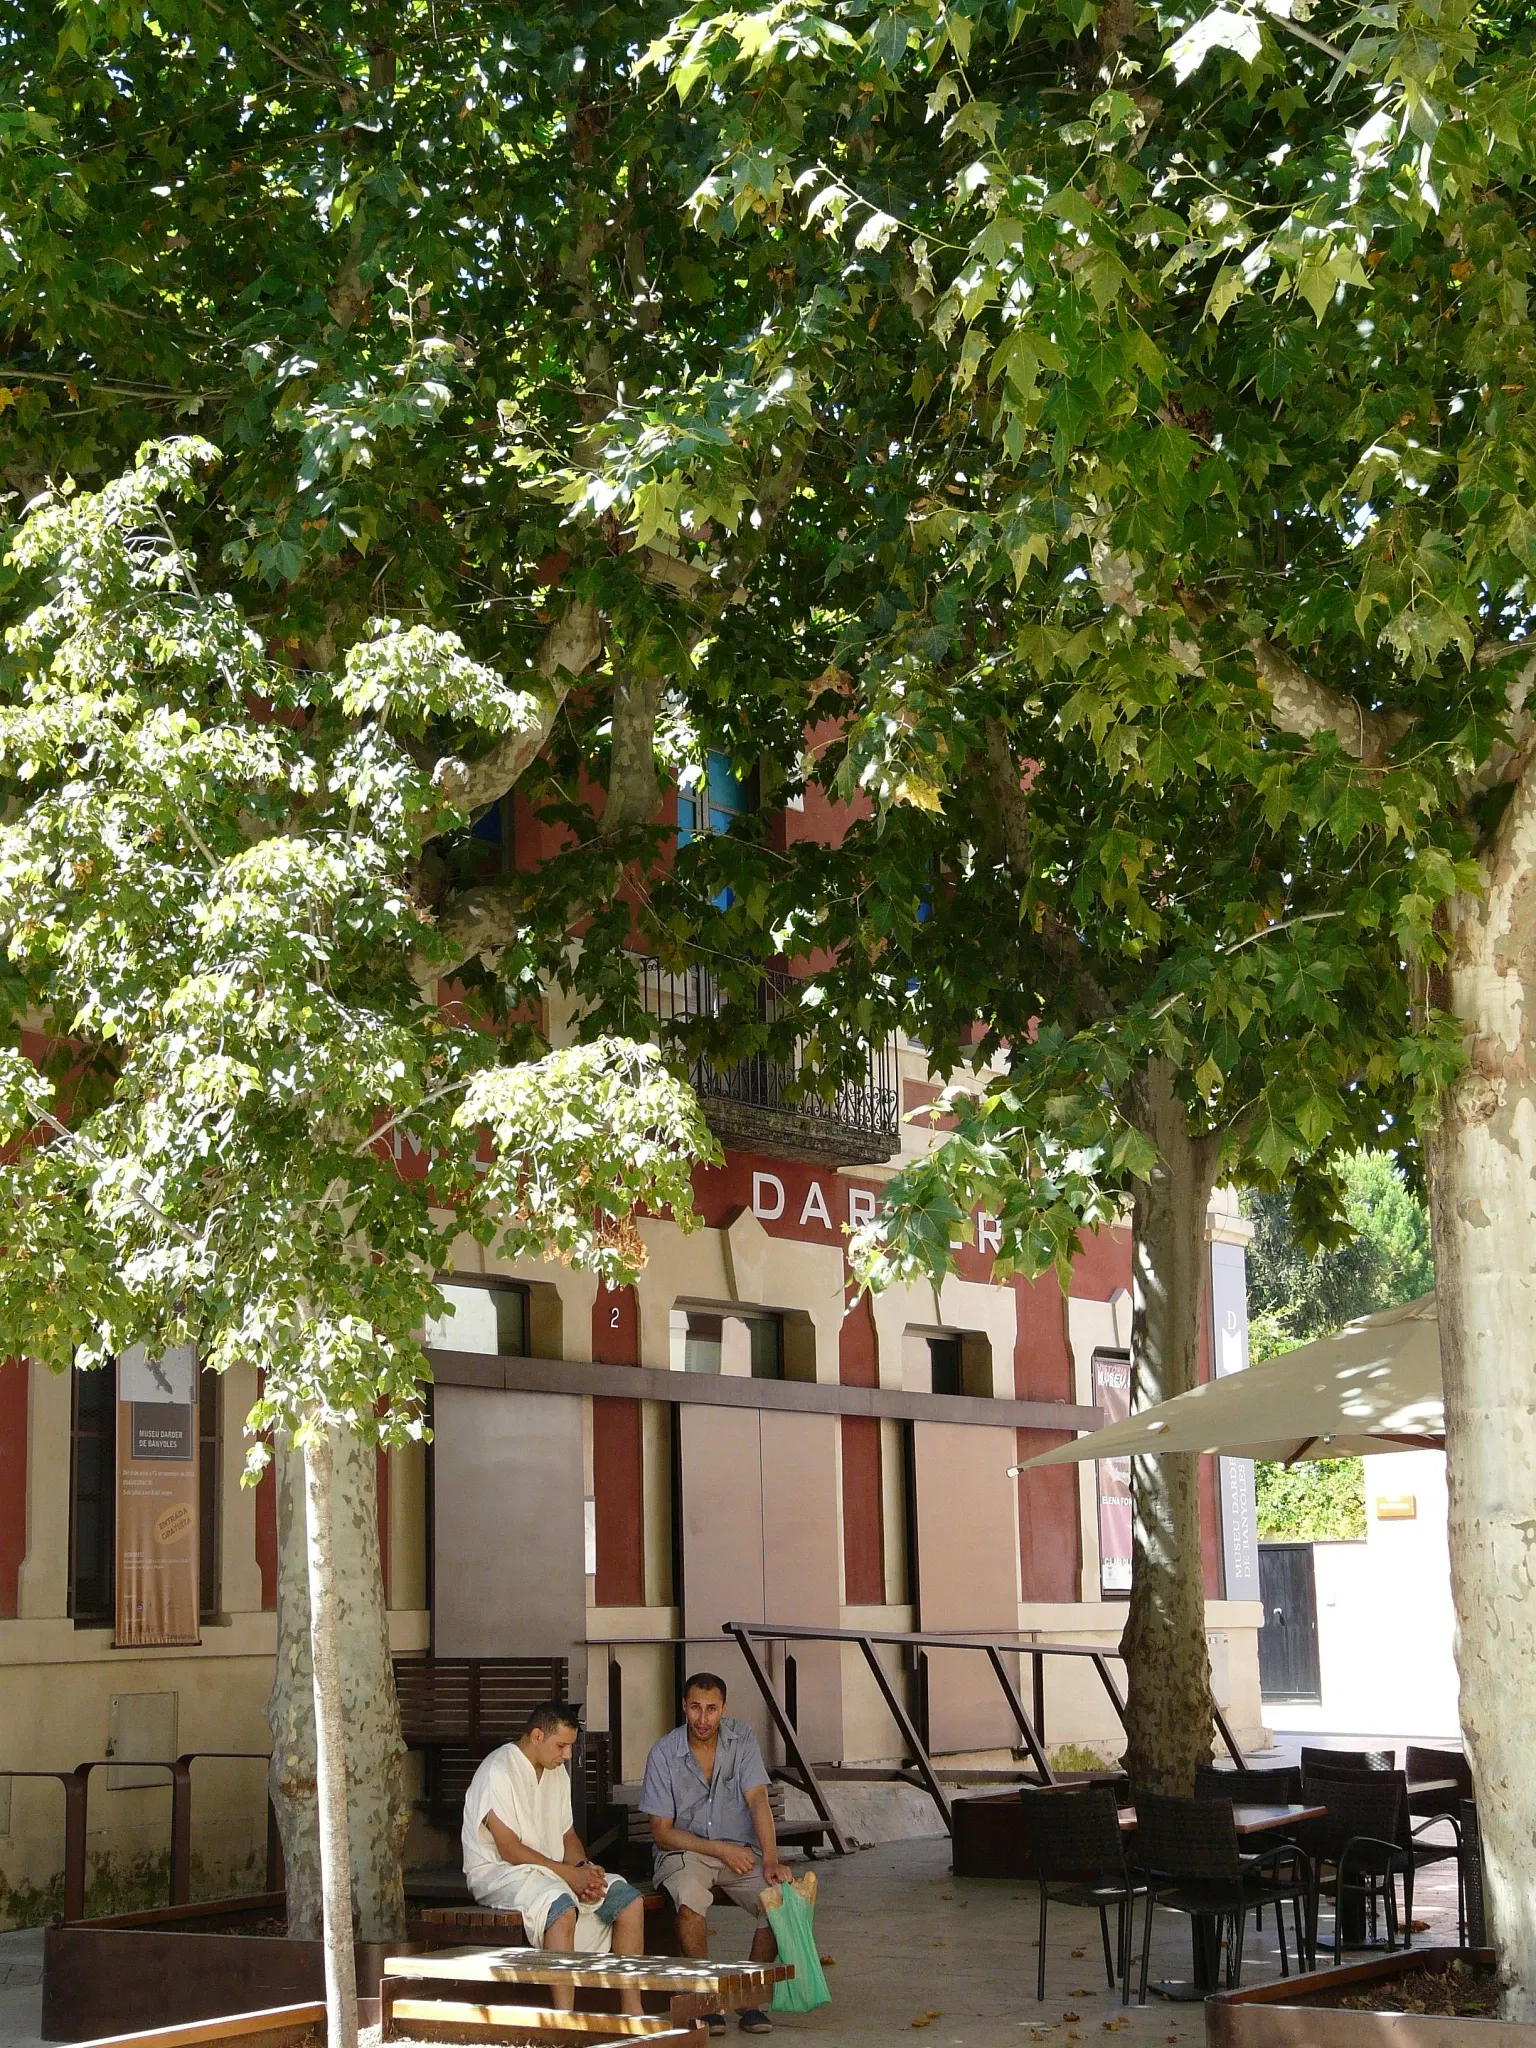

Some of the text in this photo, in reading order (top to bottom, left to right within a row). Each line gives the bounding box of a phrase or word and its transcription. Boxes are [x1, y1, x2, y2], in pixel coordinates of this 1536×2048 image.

[753, 1171, 1001, 1254] DARR
[610, 1307, 620, 1329] 2
[1226, 1310, 1237, 1330] D
[139, 1429, 183, 1439] MUSEU DARDER
[139, 1439, 177, 1448] DE BANYOLES
[158, 1507, 188, 1530] ENTRADA
[1229, 1457, 1243, 1579] MUSEU DARDE
[1238, 1464, 1251, 1579] DE BANYOLES
